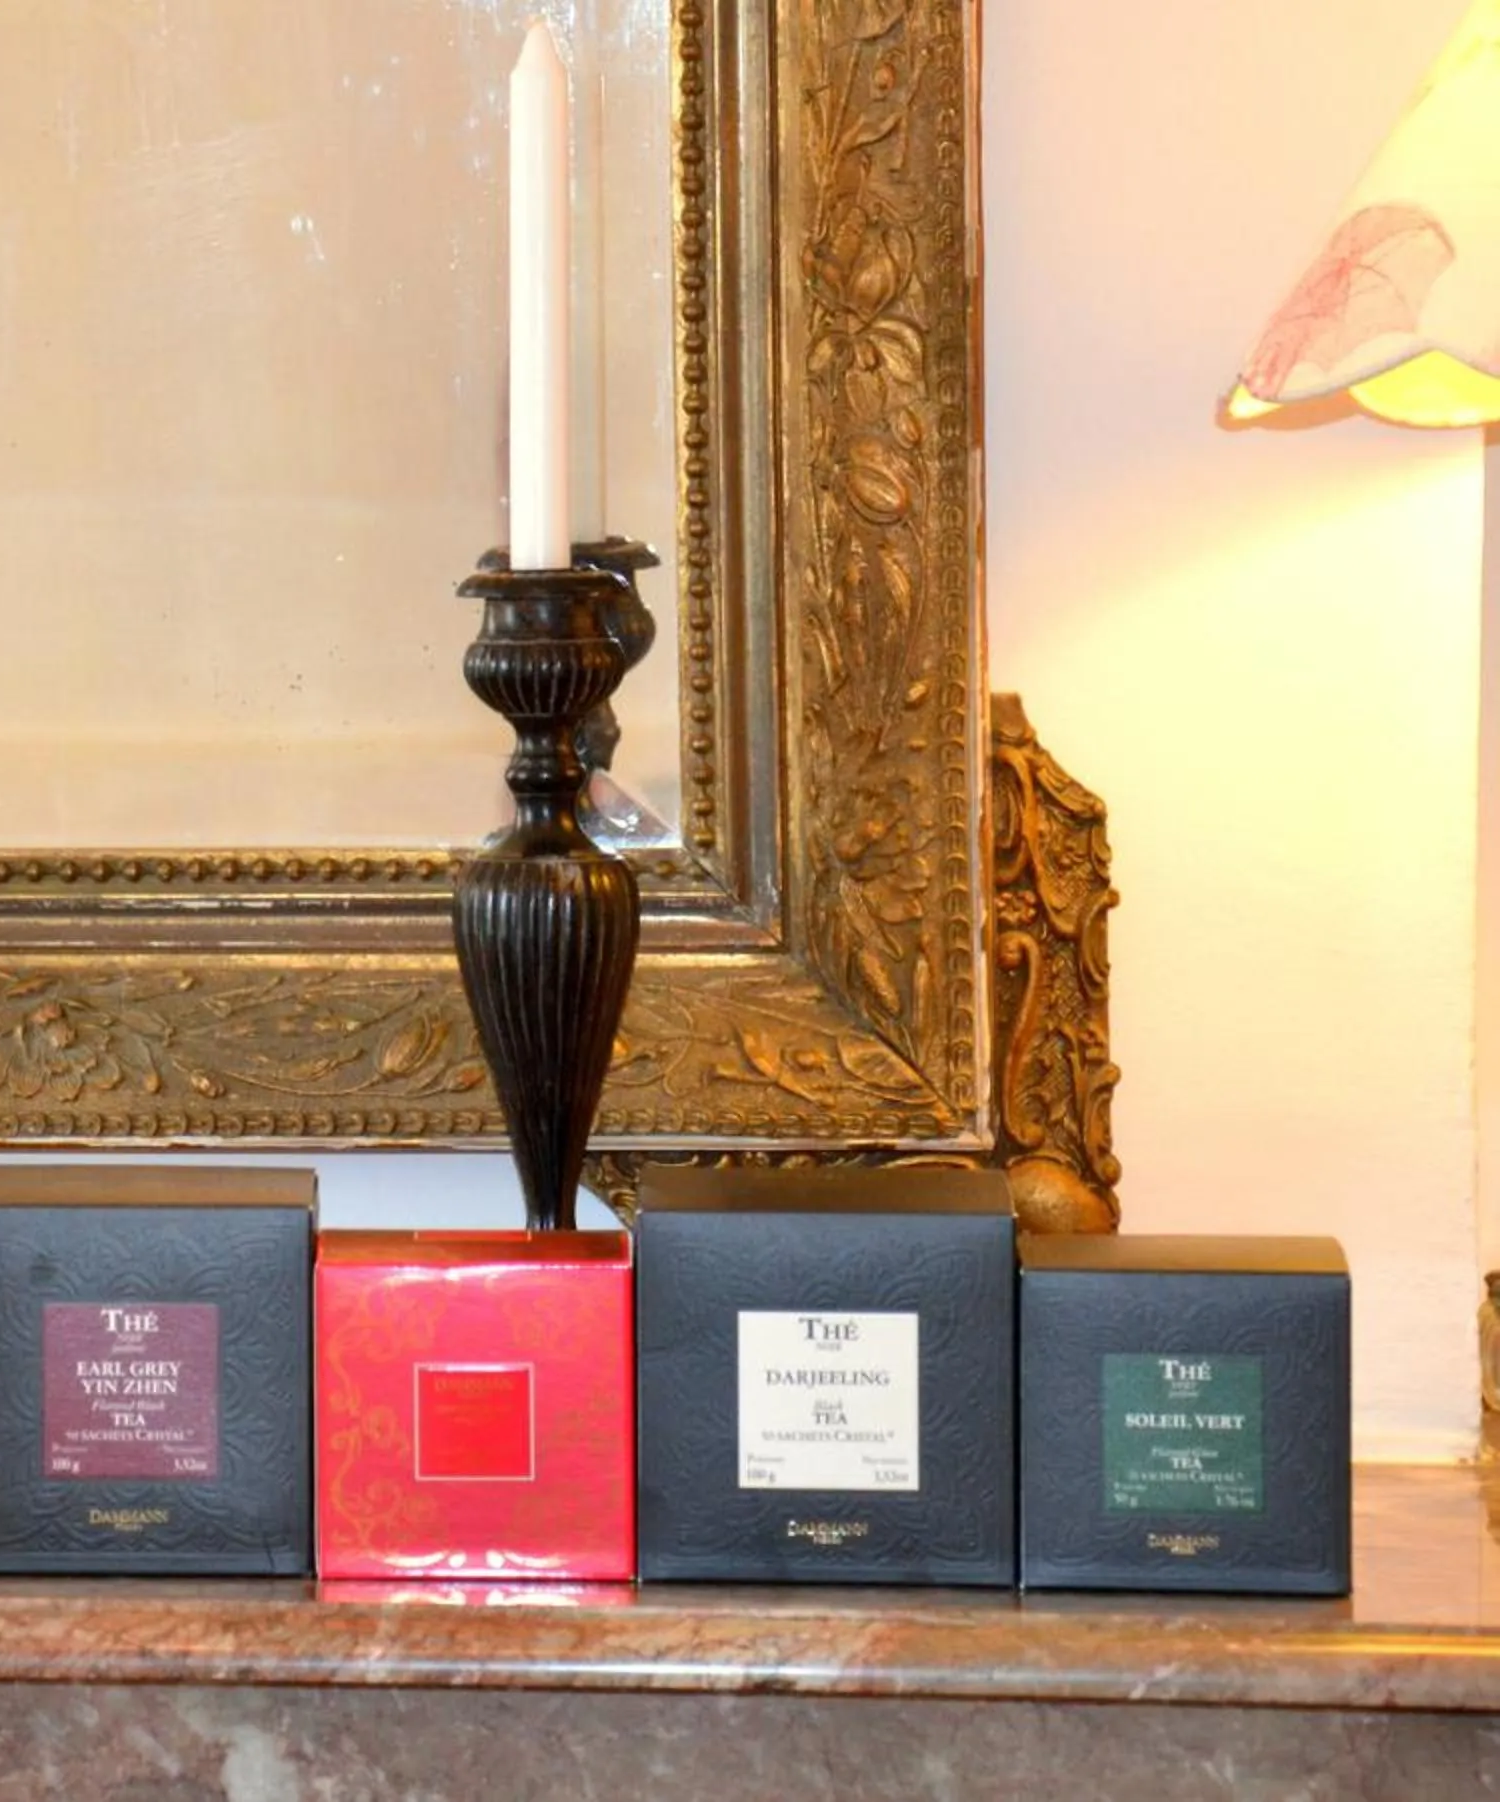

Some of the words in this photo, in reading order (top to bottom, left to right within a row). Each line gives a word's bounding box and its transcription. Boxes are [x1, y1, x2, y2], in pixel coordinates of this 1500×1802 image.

[76, 1361, 125, 1377] EARL
[129, 1361, 182, 1377] GREY
[765, 1369, 890, 1388] DARJEELING
[81, 1379, 118, 1394] YIN
[122, 1379, 178, 1394] ZHEN
[112, 1413, 146, 1427] TEA
[813, 1411, 848, 1425] TEA
[1125, 1413, 1192, 1429] SOLEIL
[1195, 1413, 1245, 1430] VERT
[1170, 1457, 1203, 1469] TEA
